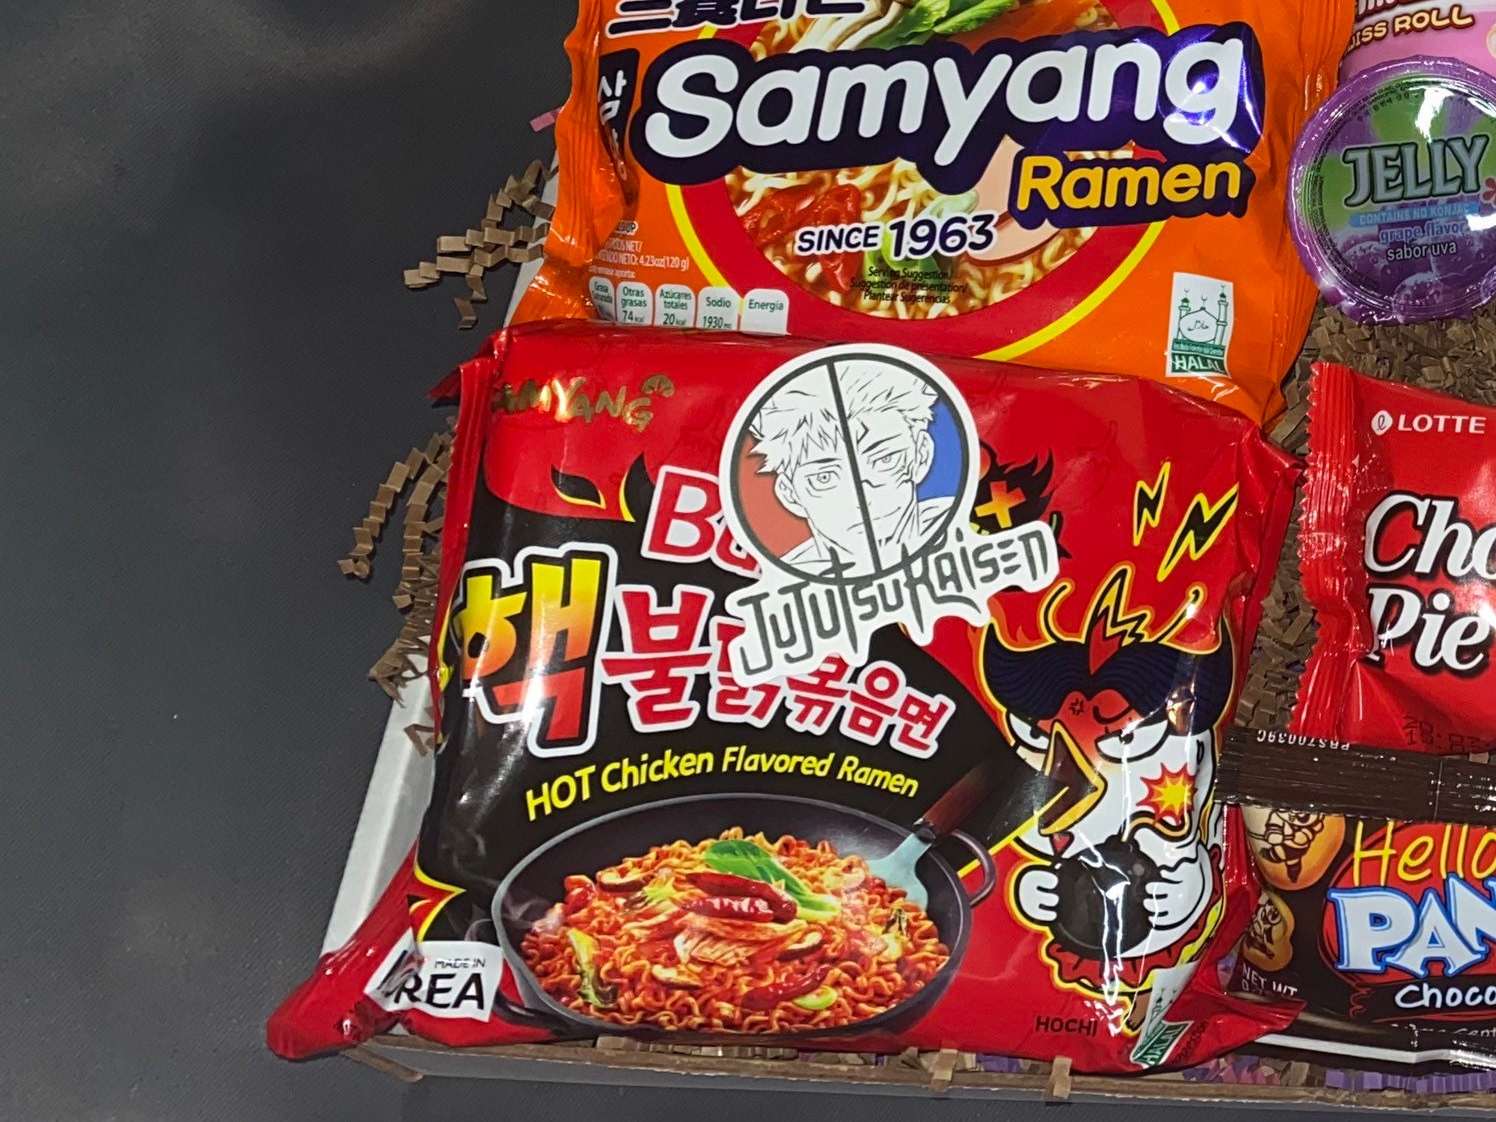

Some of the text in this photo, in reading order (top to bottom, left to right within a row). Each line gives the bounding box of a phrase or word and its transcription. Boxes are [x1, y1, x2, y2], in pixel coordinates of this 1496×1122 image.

[1394, 6, 1474, 33] ROLL
[645, 38, 1244, 167] Samyang
[1341, 134, 1490, 208] JELLY
[1017, 156, 1240, 212] Ramen
[1359, 203, 1471, 225] CONTAINS NO KONJAC
[798, 217, 996, 258] SINCE 1963
[1379, 220, 1468, 246] grape flavor
[1386, 241, 1458, 262] sabor uva
[621, 298, 648, 308] grasas
[622, 287, 645, 297] Otras
[660, 289, 692, 300] Azúcares
[706, 297, 732, 308] Sodio
[622, 310, 634, 322] 74
[664, 300, 688, 310] totales
[663, 313, 675, 325] 20
[703, 315, 724, 330] 1930
[1174, 355, 1227, 374] HALAL
[1398, 413, 1486, 434] LOTTE
[1366, 587, 1490, 671] Pie
[462, 558, 604, 742] 핵
[525, 744, 921, 822] HOT Chicken Flavored Ramen
[1242, 962, 1268, 989] NET
[1035, 1015, 1098, 1038] HOCHI
